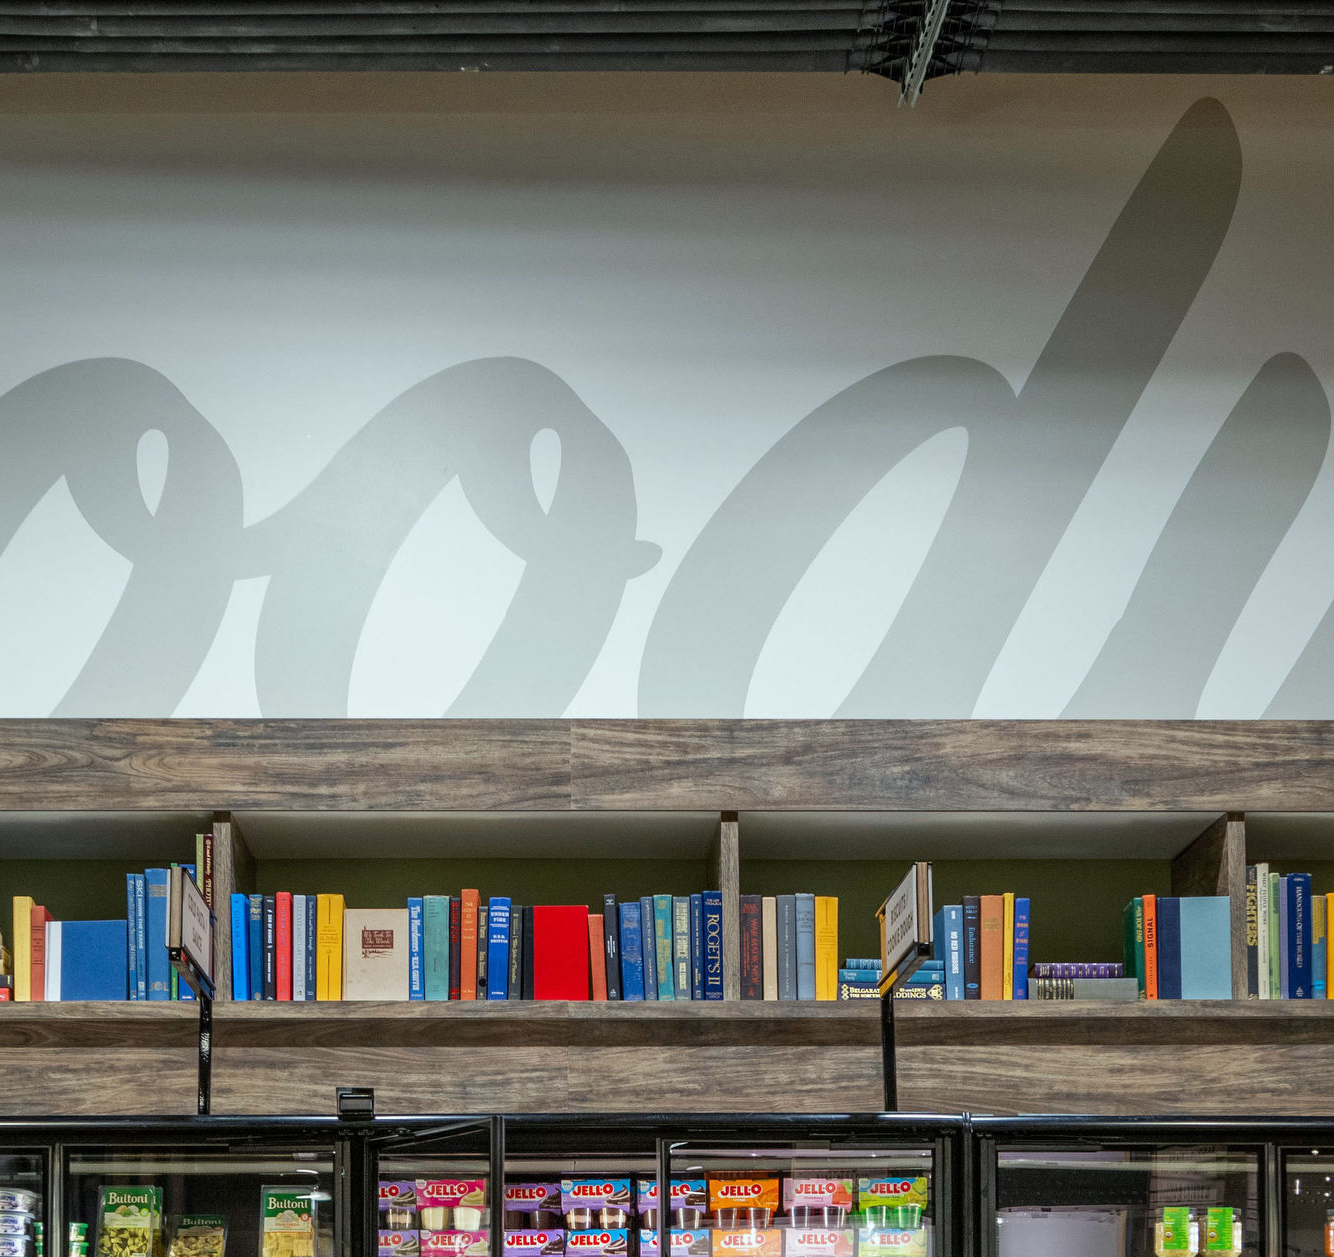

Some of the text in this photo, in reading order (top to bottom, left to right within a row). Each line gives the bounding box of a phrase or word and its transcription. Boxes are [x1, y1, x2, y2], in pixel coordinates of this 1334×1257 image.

[410, 906, 420, 952] The Murderers
[1247, 885, 1257, 945] FIGHTERS
[707, 914, 719, 985] ROGET'S II
[968, 927, 976, 963] Endurance
[106, 1191, 149, 1206] Buitoni
